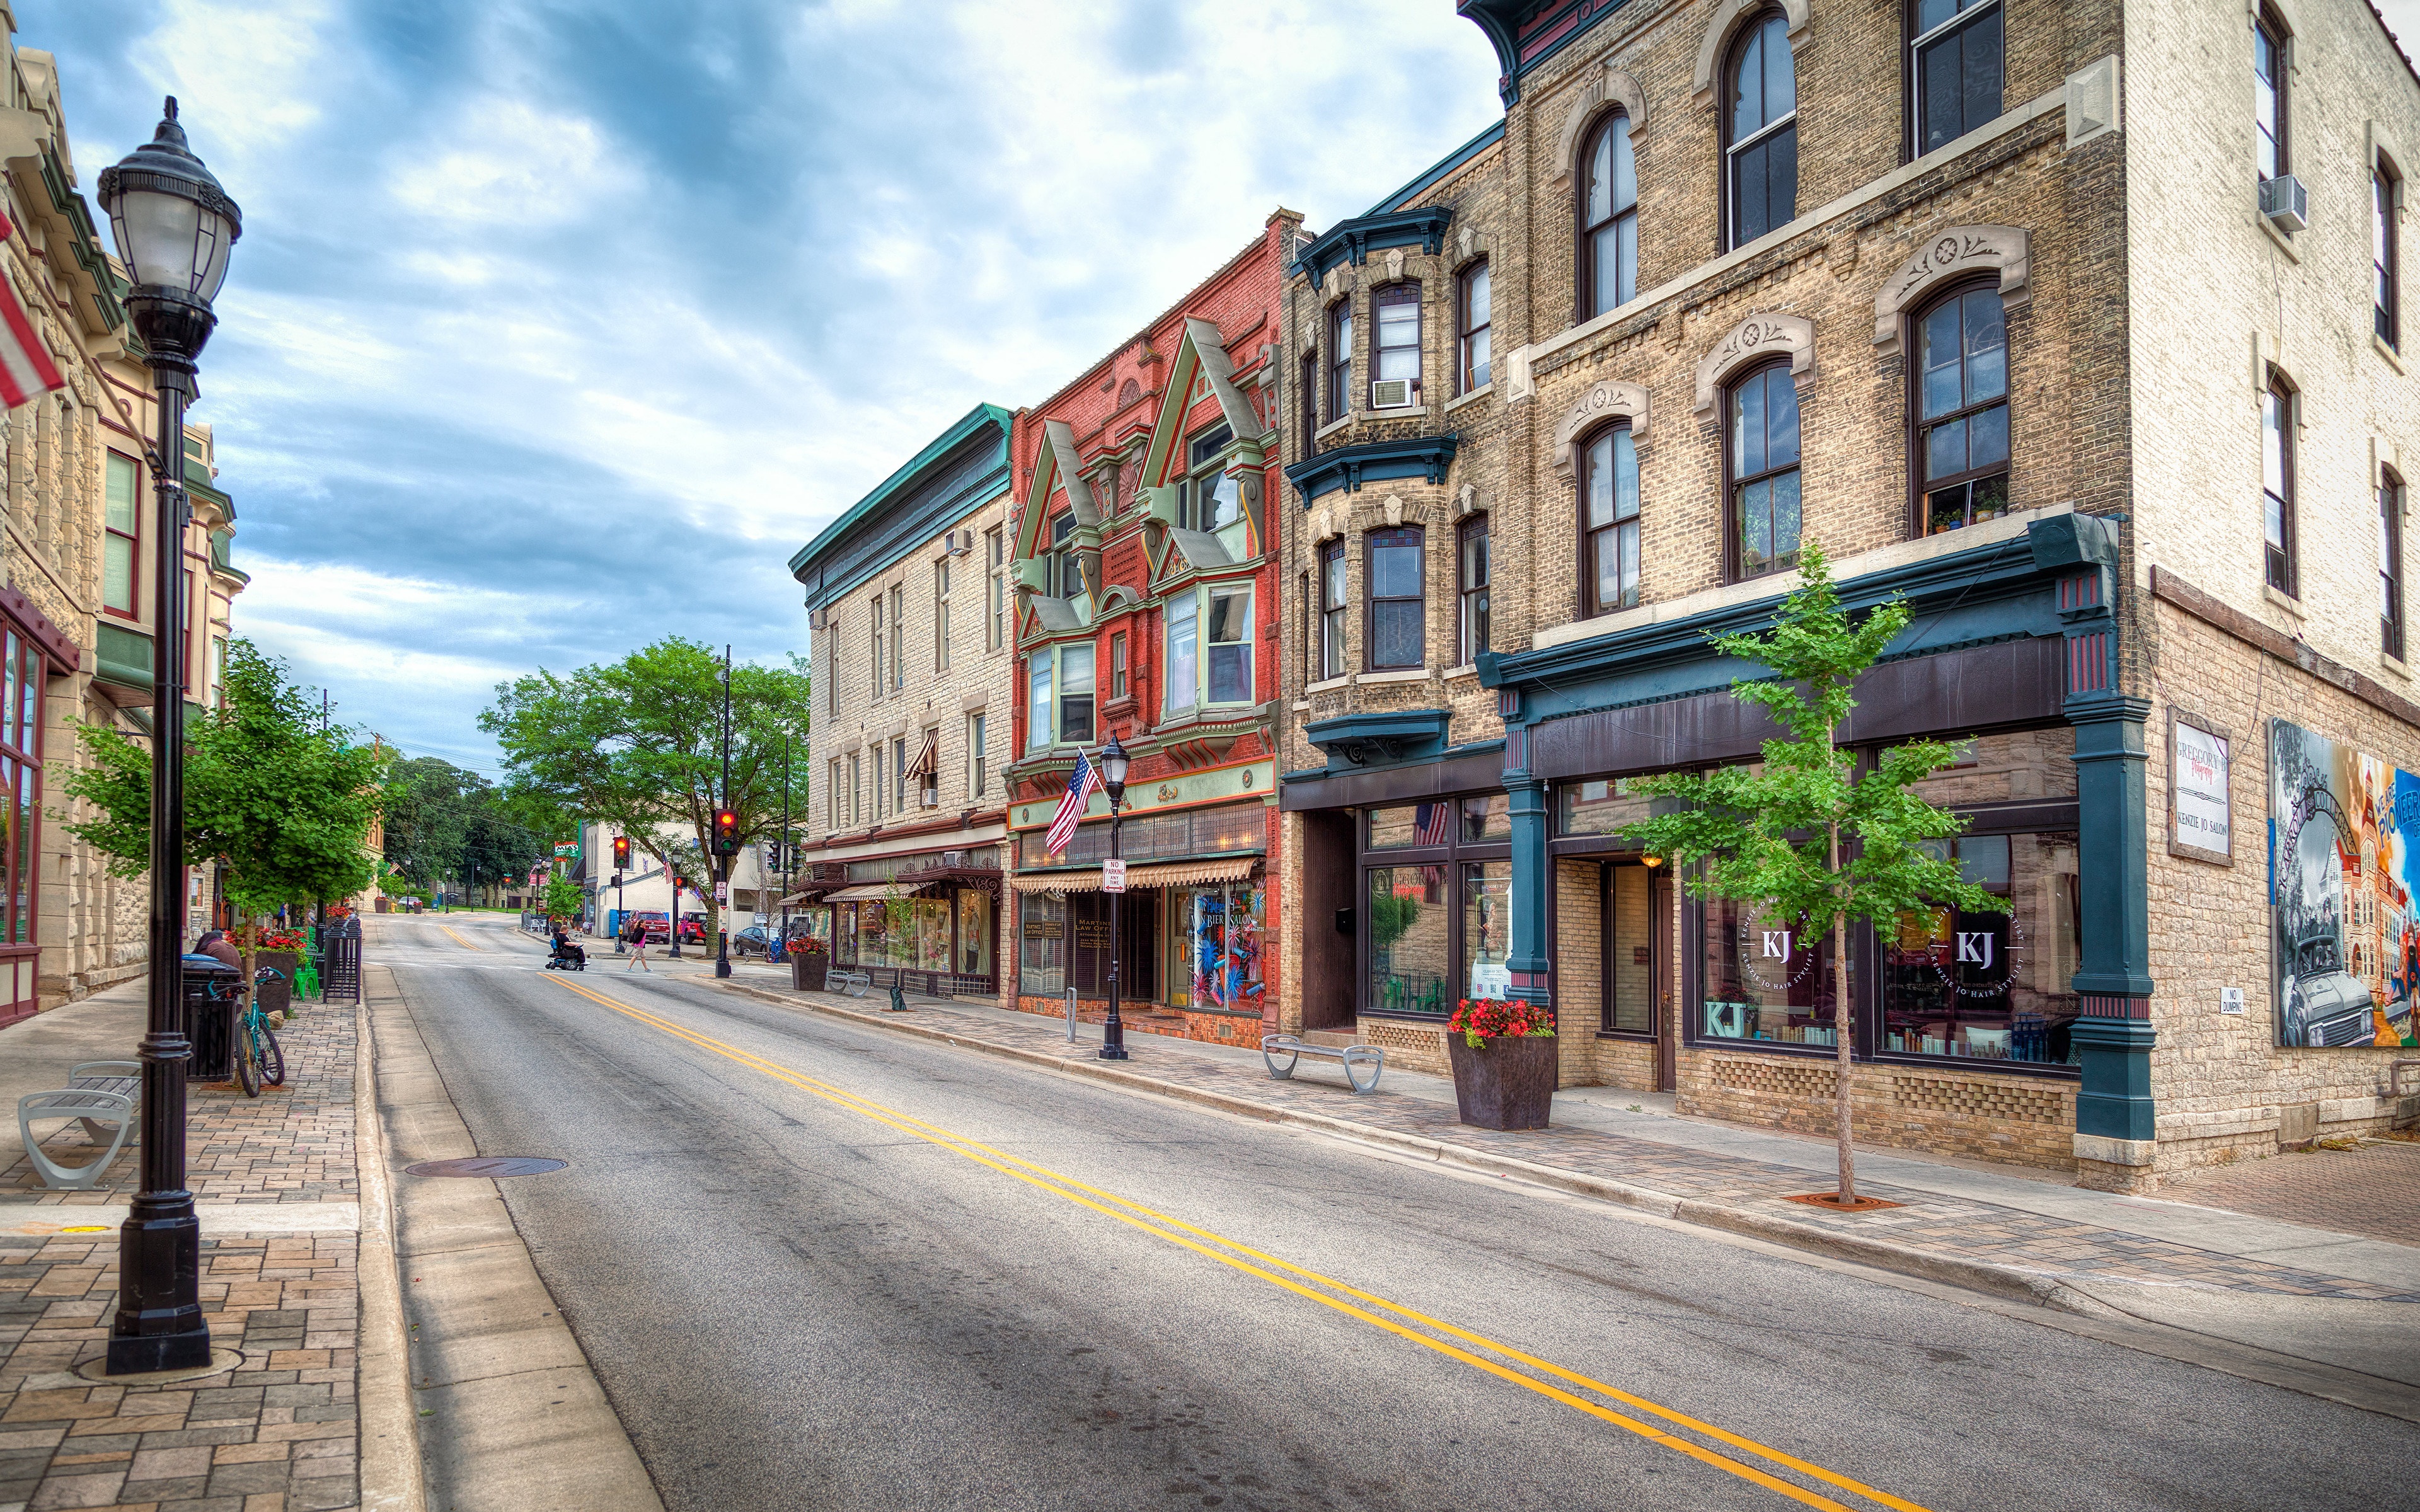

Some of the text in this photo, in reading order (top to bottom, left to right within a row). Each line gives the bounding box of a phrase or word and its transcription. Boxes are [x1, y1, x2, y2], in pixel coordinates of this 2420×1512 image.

[2176, 741, 2227, 772] GREGGORY B
[2375, 782, 2395, 816] WE ARE
[2177, 811, 2227, 836] KENZIE JO SALON
[2378, 791, 2420, 849] PIONEER
[1207, 915, 1224, 928] BIER
[1230, 915, 1254, 928] SALON
[1741, 909, 1756, 938] KENZIE
[1761, 931, 1791, 964] KJ
[1956, 932, 1995, 970] KJ
[1742, 953, 1760, 982] KENZIE
[1761, 980, 1770, 988] JO
[1794, 952, 1814, 983] STYLIST
[1930, 956, 1954, 988] KENZIE
[1956, 986, 1967, 995] JO
[1971, 990, 1995, 998] HAIR
[1997, 957, 2024, 992] STYLIST
[2223, 1002, 2242, 1012] DUMPING
[2230, 989, 2237, 1000] NO
[1705, 1001, 1746, 1038] KJ
